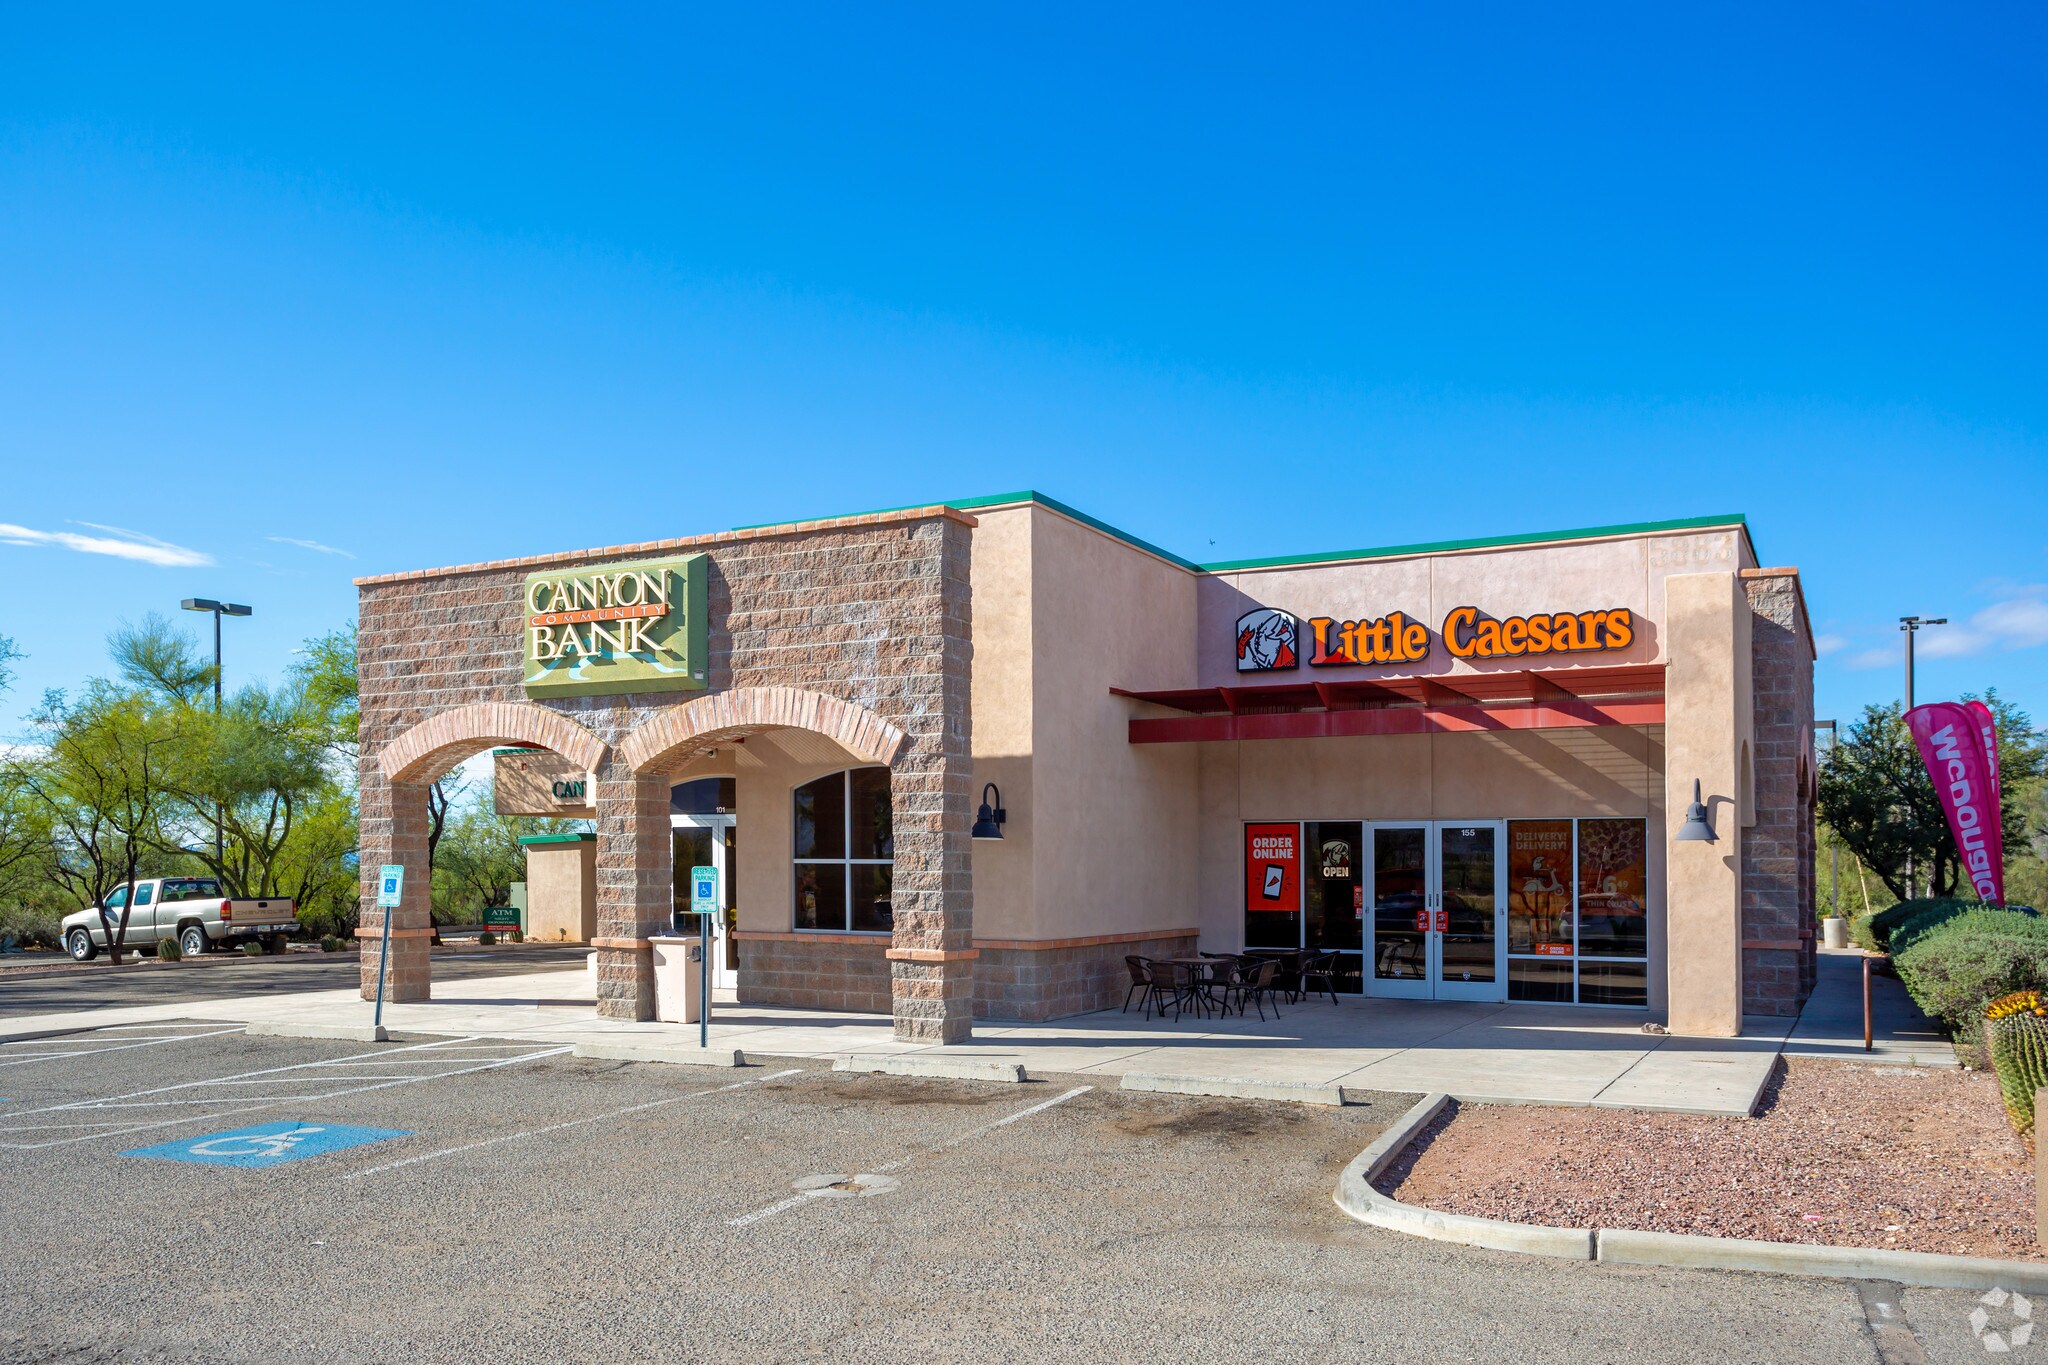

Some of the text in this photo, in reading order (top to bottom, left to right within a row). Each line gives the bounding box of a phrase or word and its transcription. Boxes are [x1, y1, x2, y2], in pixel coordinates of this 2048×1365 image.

[528, 568, 672, 615] CANYON
[531, 605, 663, 626] COMMUNITY
[529, 615, 668, 661] BANK
[1309, 606, 1634, 665] Little Caesars
[1461, 829, 1475, 837] 155
[1516, 832, 1567, 841] DELIVERY!
[1253, 837, 1293, 848] ORDER
[1516, 841, 1567, 850] DELIVERY!
[1253, 848, 1293, 859] ONLINE
[1323, 867, 1349, 877] OPEN
[235, 908, 290, 916] CHEVROLET
